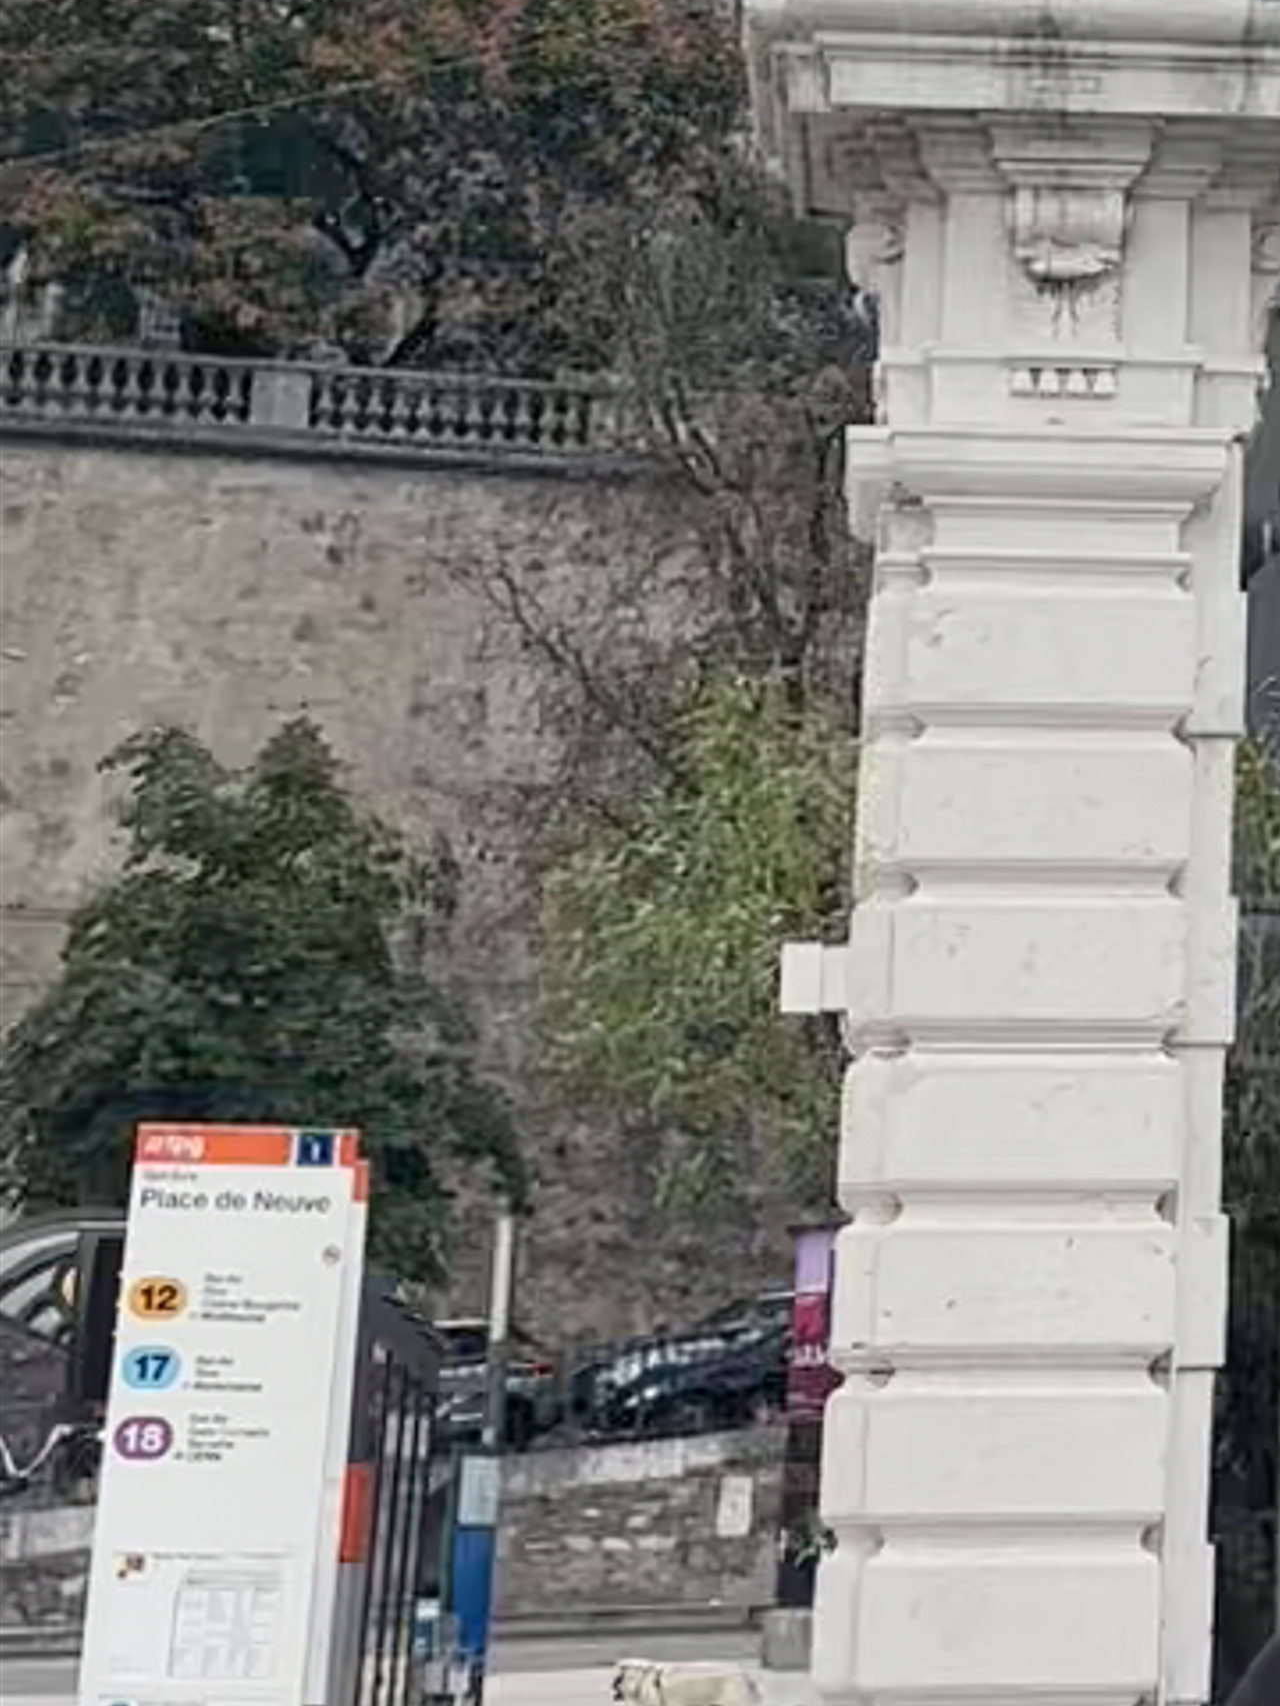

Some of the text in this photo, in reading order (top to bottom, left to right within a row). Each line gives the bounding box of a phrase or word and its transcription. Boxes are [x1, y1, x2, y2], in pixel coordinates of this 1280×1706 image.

[140, 1187, 331, 1213] Place de Neuve
[139, 1283, 178, 1312] 12
[133, 1353, 171, 1382] 17
[122, 1423, 165, 1453] 18
